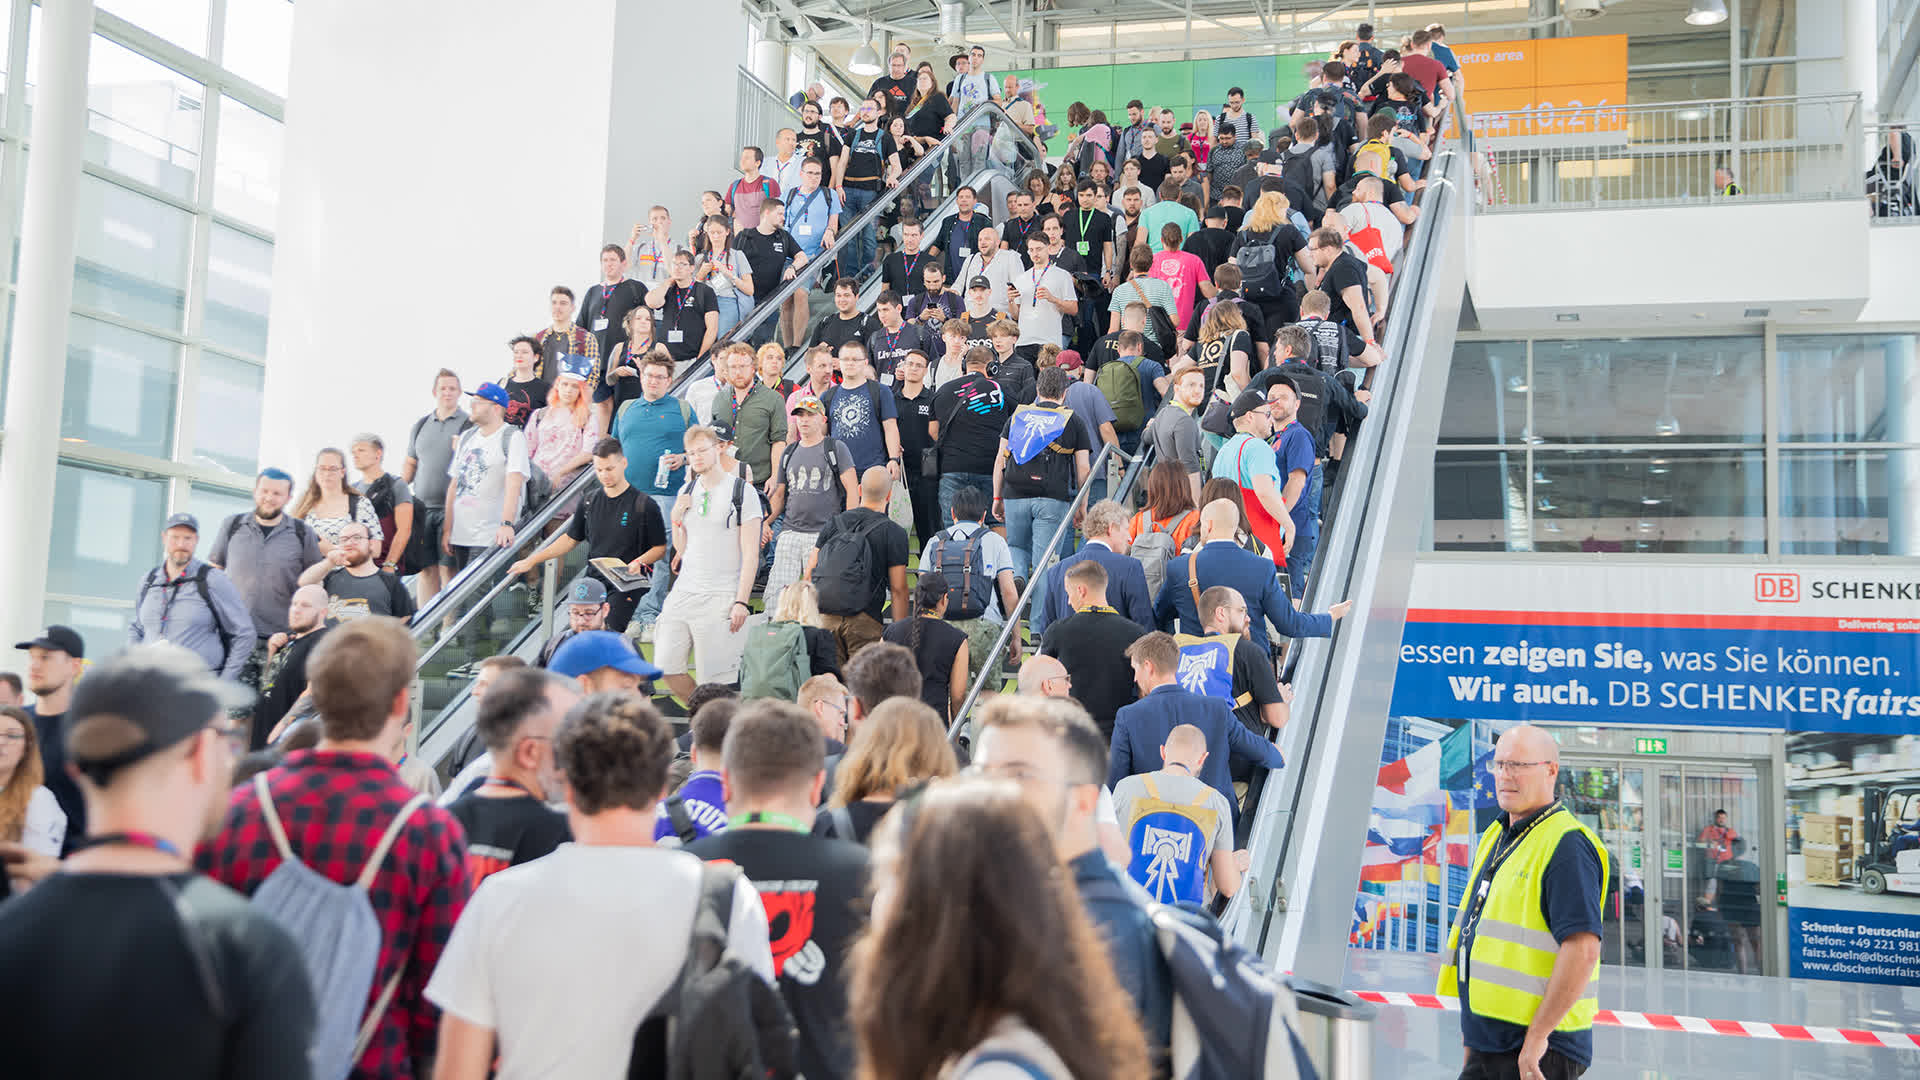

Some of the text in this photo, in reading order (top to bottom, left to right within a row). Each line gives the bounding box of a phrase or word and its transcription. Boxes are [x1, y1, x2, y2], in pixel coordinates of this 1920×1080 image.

[1493, 50, 1524, 62] area
[1760, 577, 1795, 598] DB
[1838, 619, 1895, 632] Delivering
[1400, 640, 1900, 677] essen zeigen Sie, was Sie können.
[1448, 675, 1506, 702] Wir
[1512, 679, 1599, 707] auch.
[1608, 680, 1651, 707] DB
[1801, 921, 1855, 935] Schenker
[1802, 934, 1920, 952] Telefon: +49 221 981
